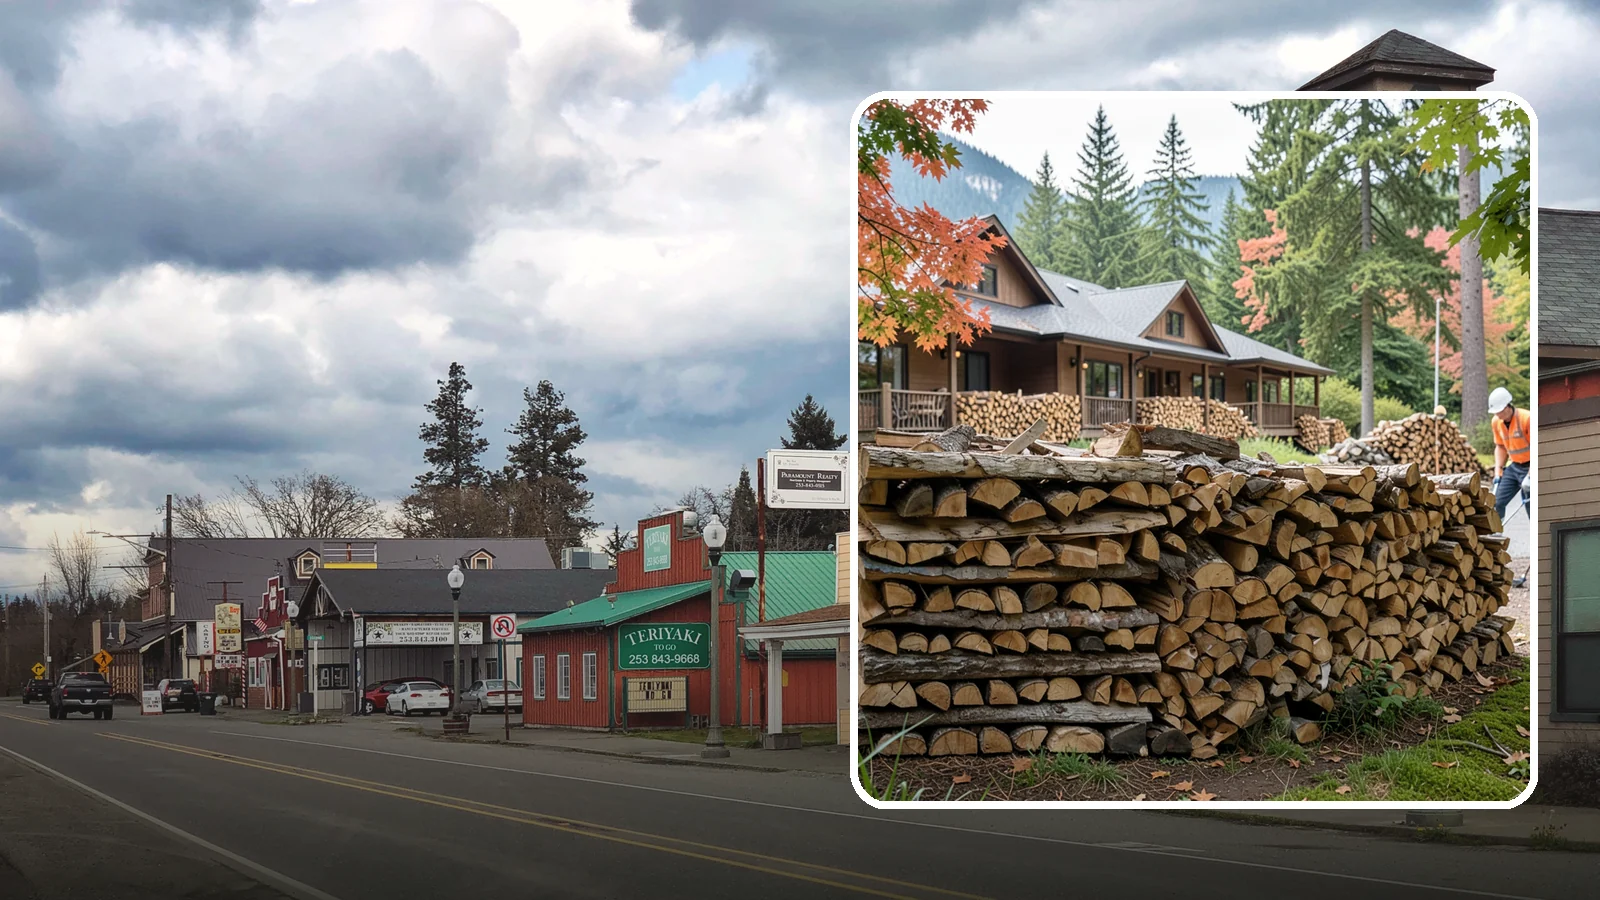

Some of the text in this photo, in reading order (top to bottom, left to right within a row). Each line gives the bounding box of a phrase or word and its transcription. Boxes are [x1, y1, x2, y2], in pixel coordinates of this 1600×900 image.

[817, 472, 839, 480] REALTY
[625, 627, 702, 646] TERIYAKI
[629, 653, 700, 664] 253 843-9668
[639, 681, 672, 691] TERIYAKI
